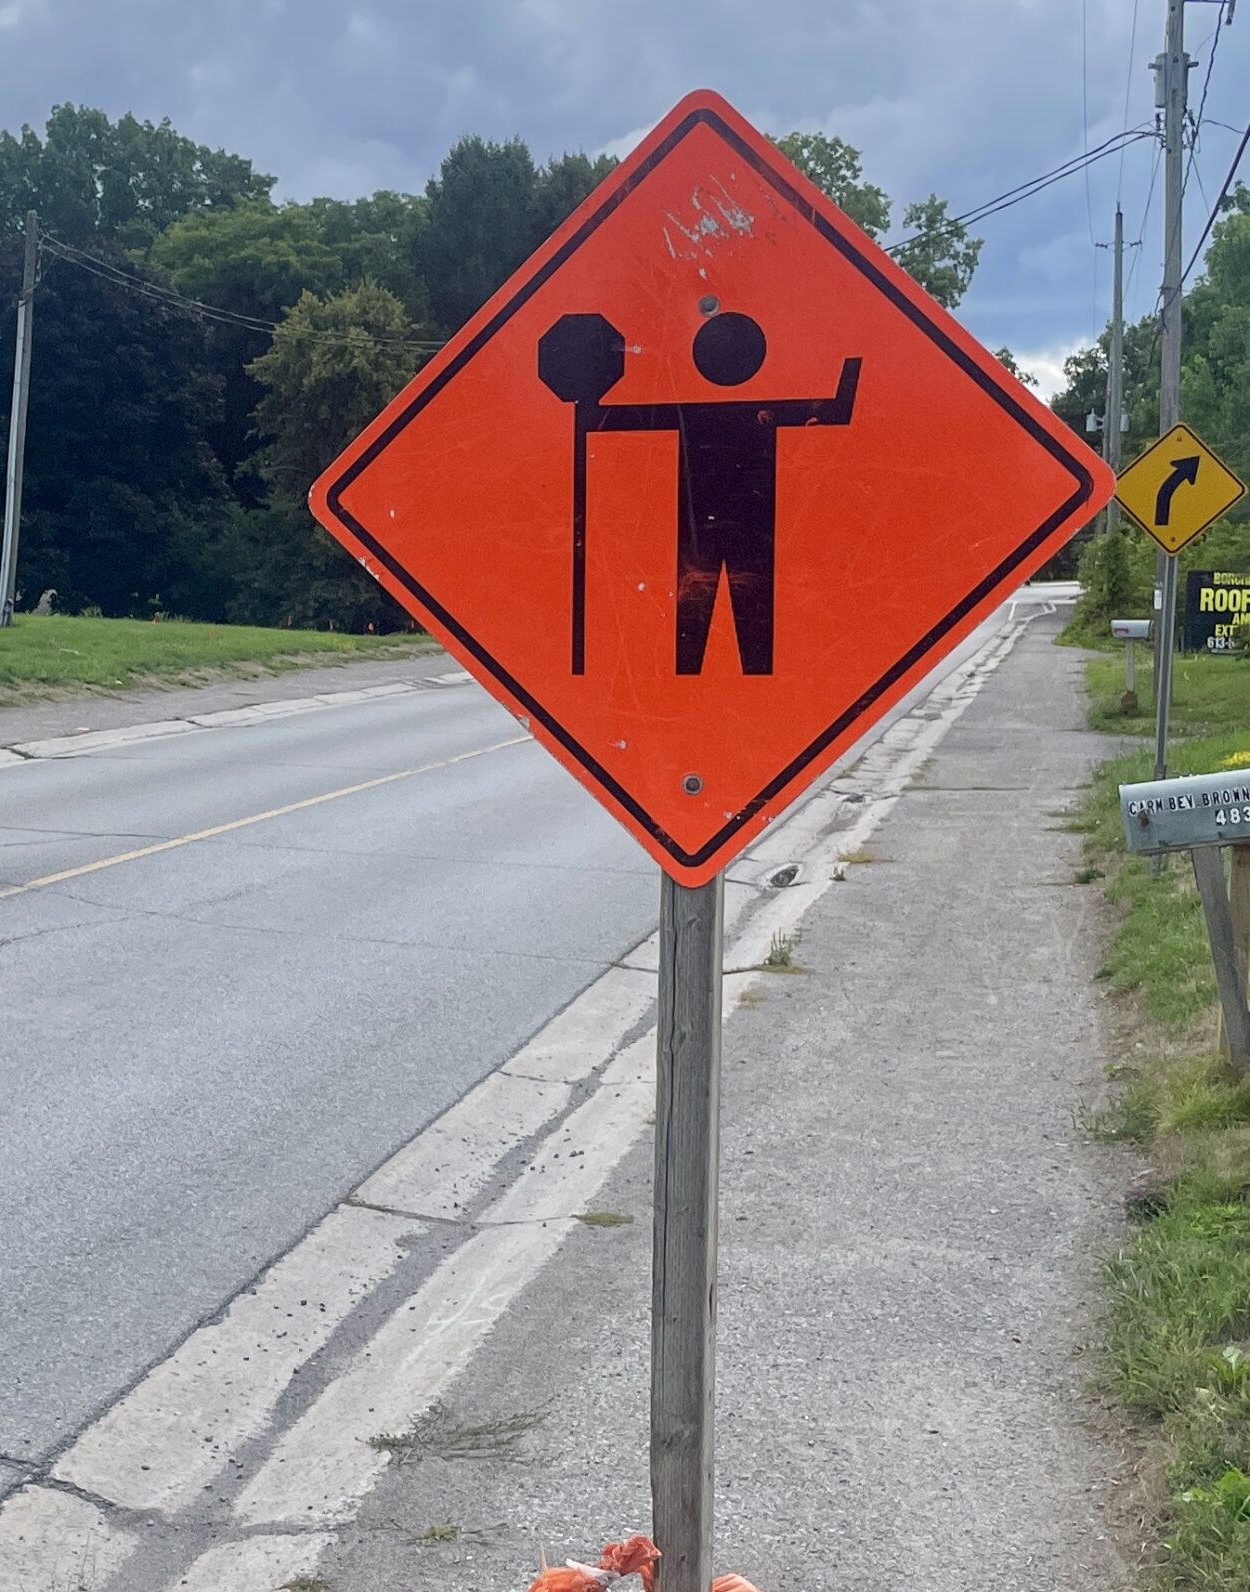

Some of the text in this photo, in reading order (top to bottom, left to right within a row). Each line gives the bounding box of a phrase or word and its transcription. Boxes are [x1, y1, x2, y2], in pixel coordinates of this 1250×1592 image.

[1200, 588, 1250, 612] ROOF
[1215, 624, 1238, 637] EXT
[1169, 794, 1193, 810] BEV
[1202, 787, 1250, 806] BROWN
[1215, 806, 1250, 826] 483
